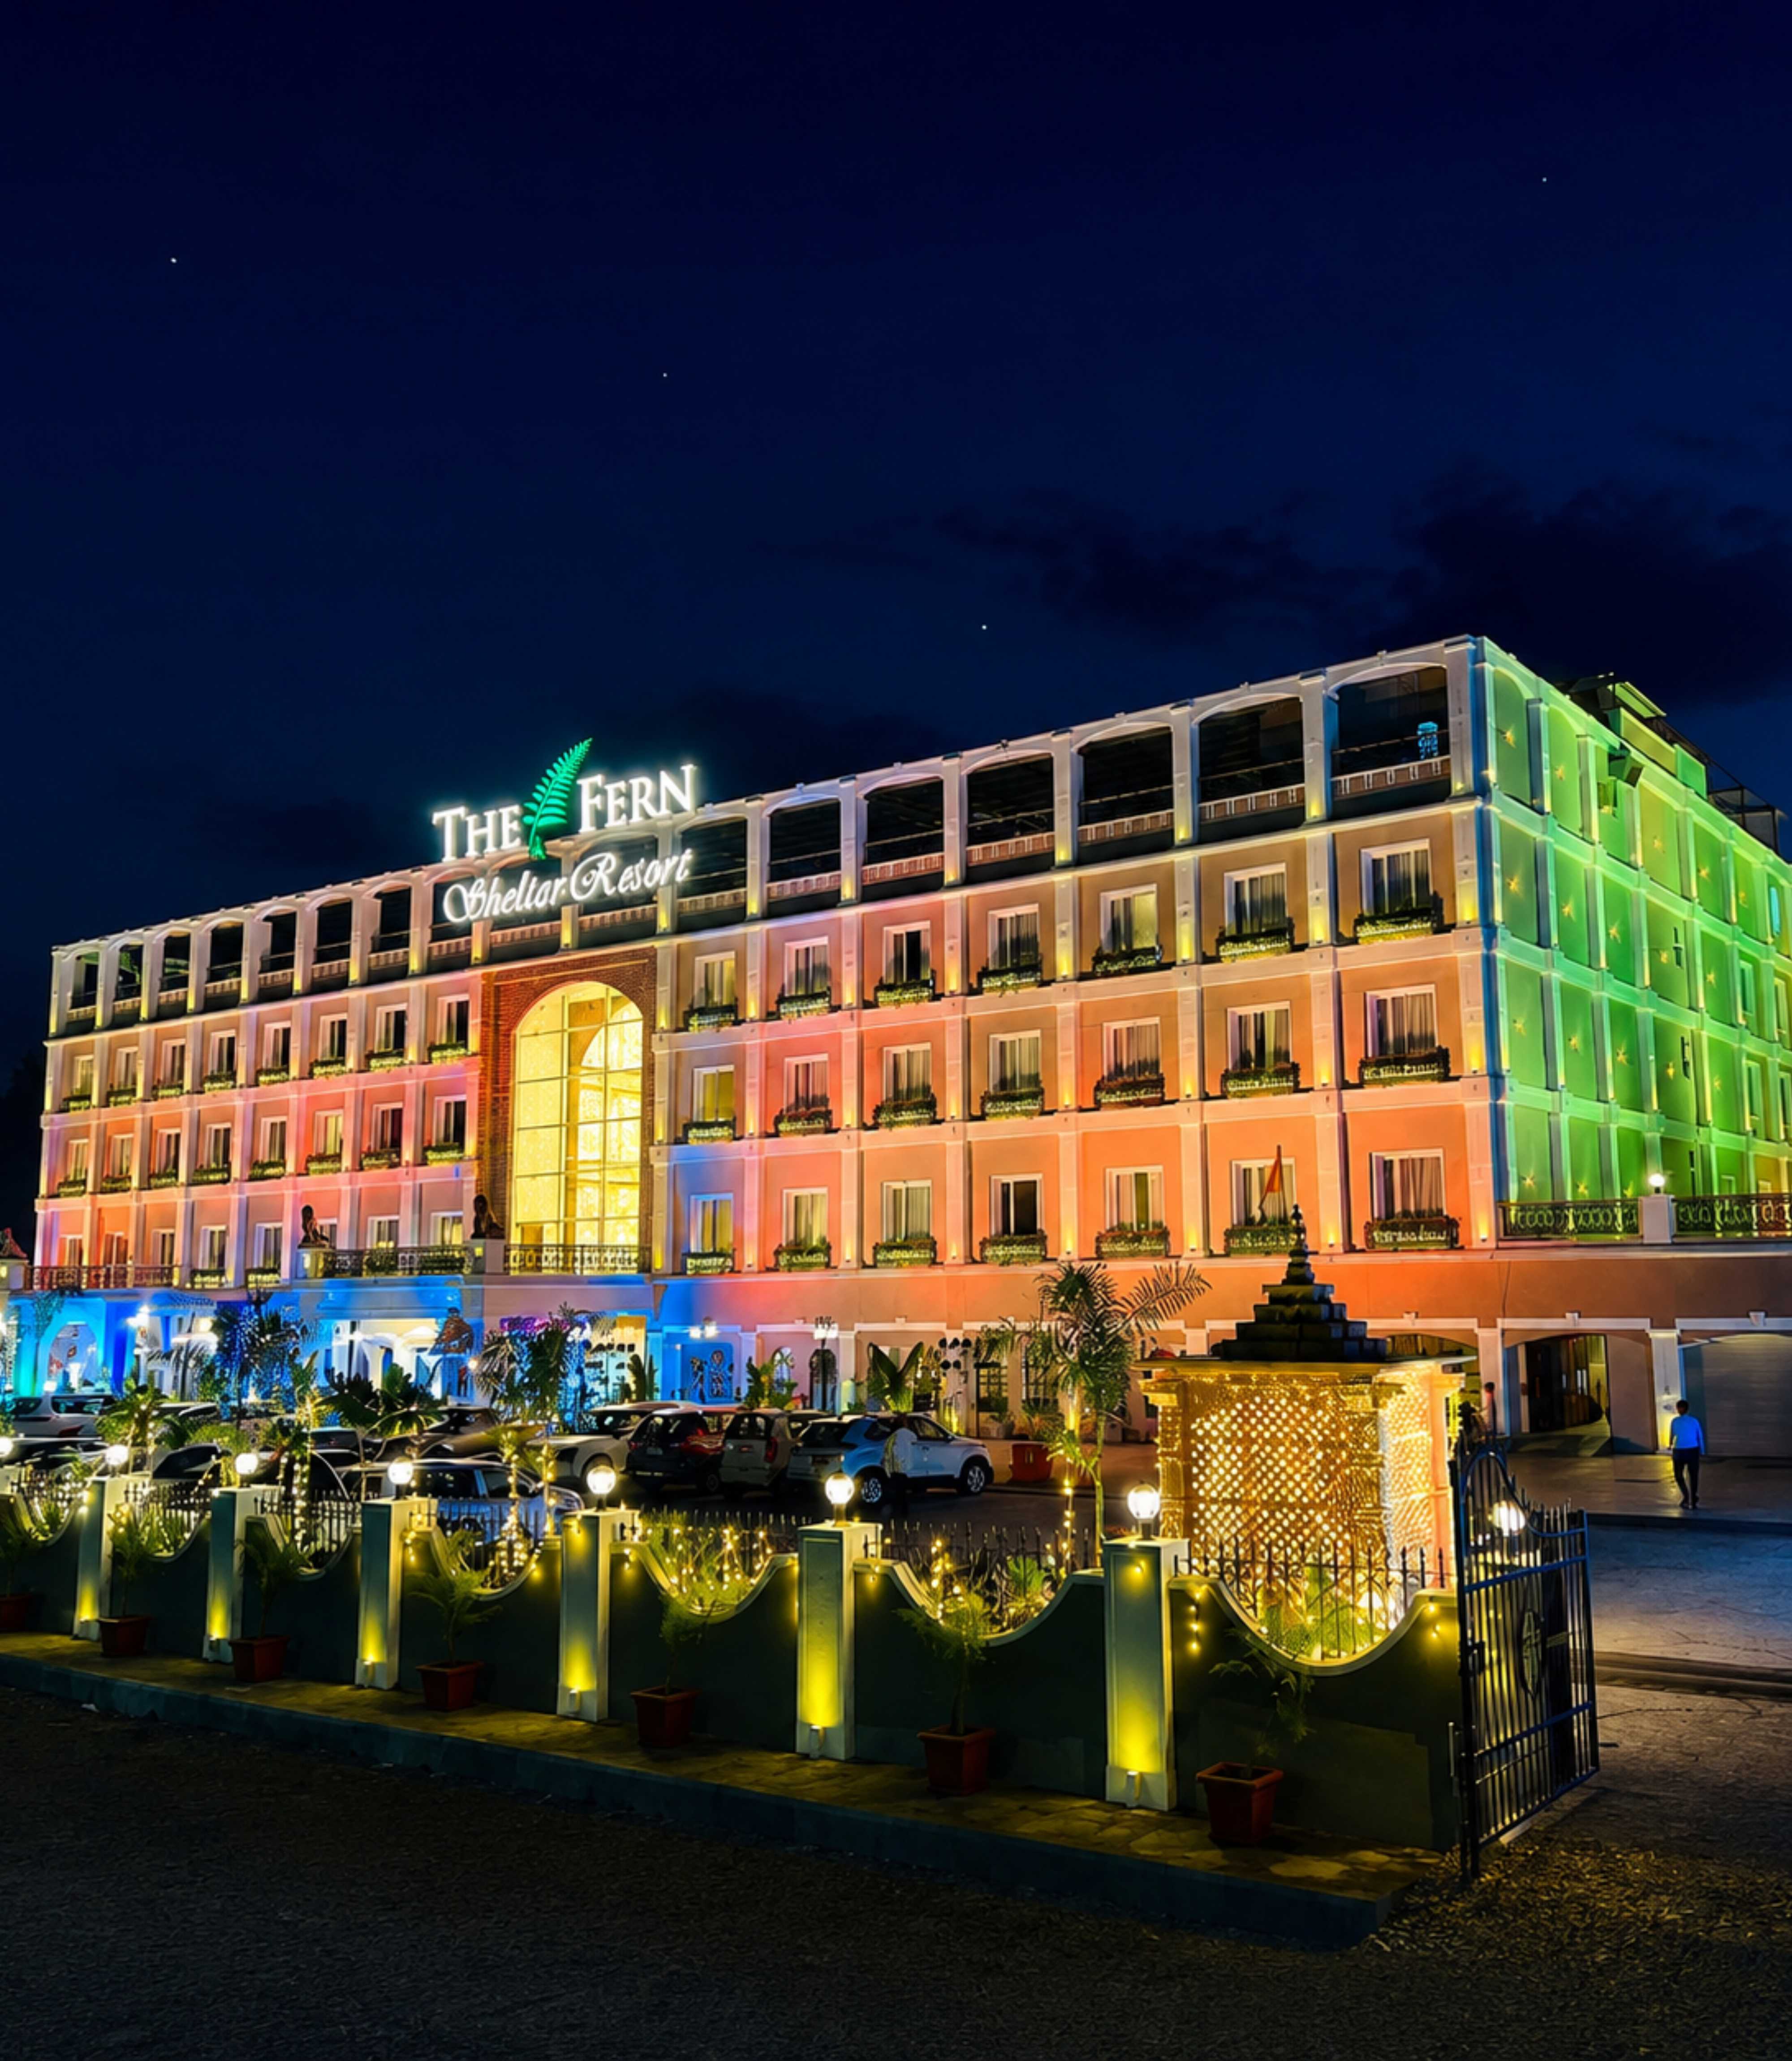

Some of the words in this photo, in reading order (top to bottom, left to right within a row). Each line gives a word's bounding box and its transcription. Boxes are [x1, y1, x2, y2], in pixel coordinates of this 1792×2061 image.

[432, 805, 521, 862] THE
[576, 763, 697, 833] FERN
[570, 848, 693, 901] Resort
